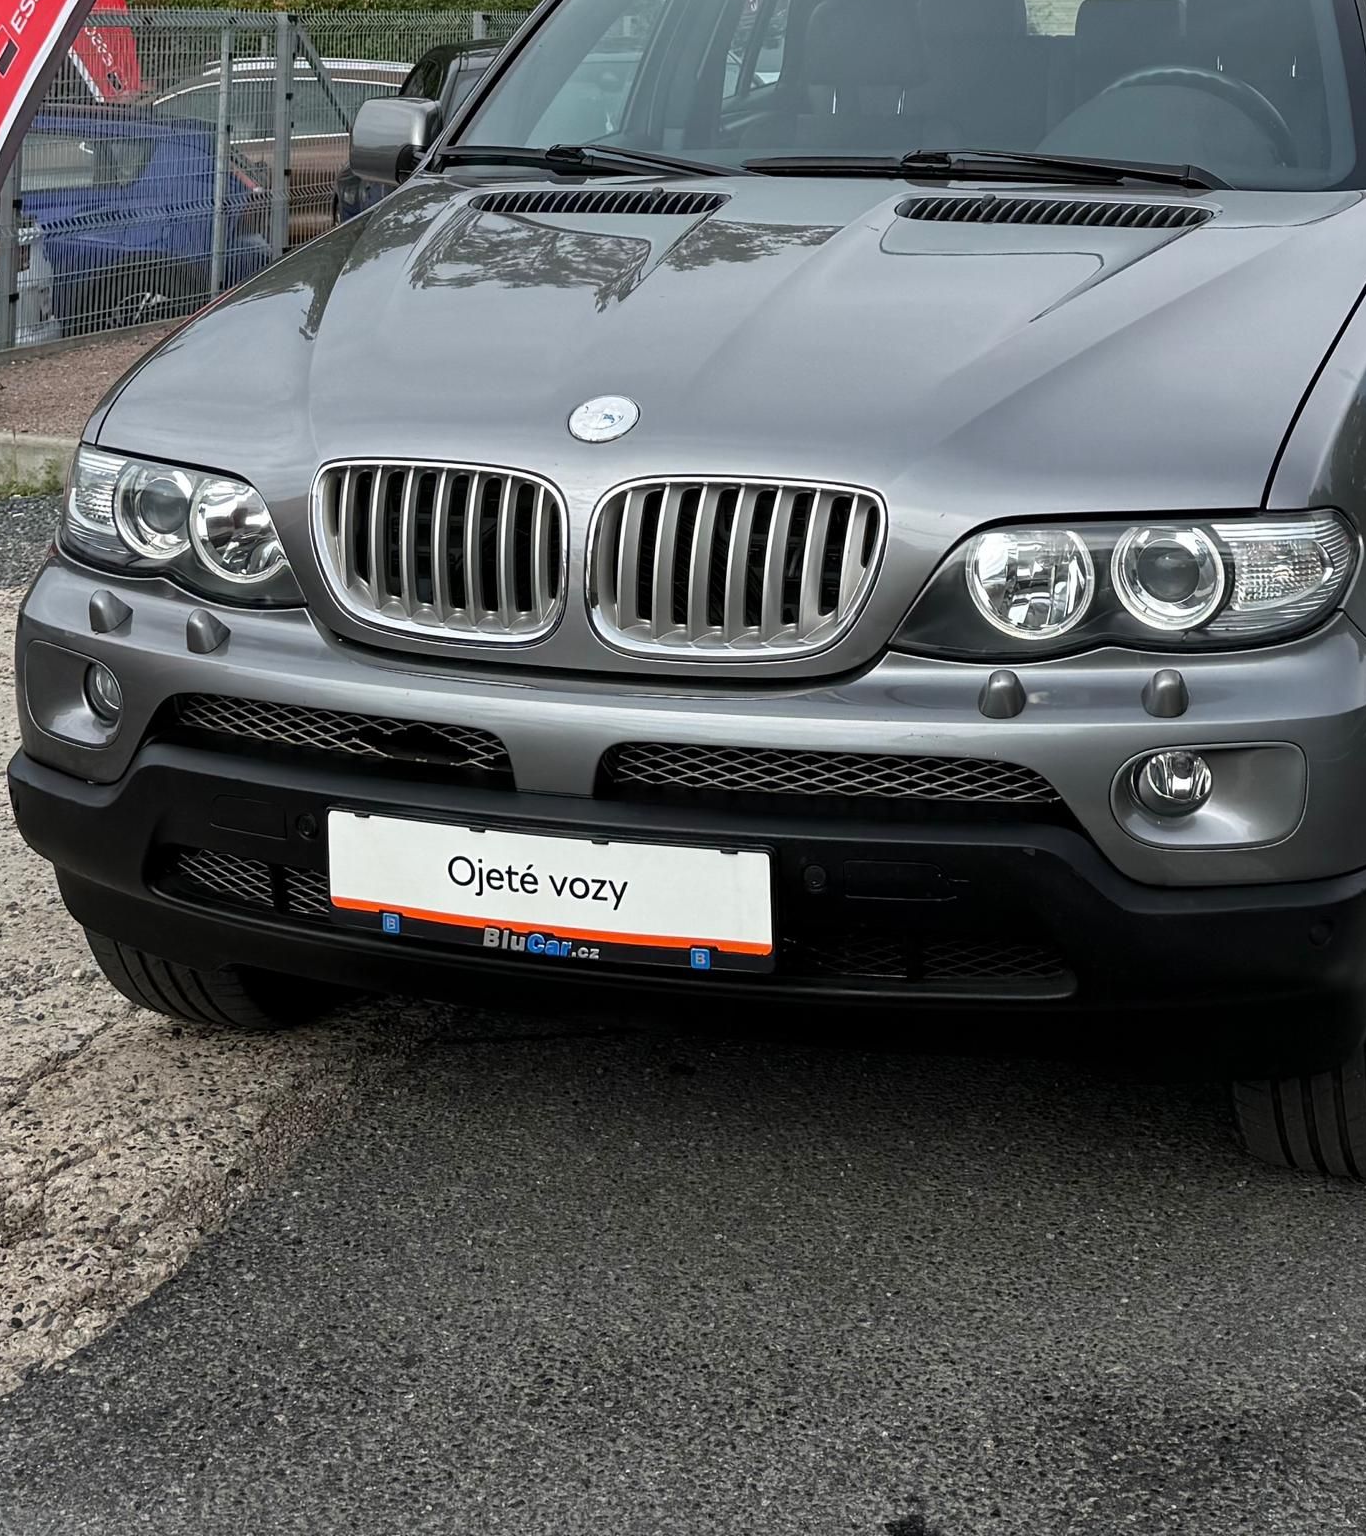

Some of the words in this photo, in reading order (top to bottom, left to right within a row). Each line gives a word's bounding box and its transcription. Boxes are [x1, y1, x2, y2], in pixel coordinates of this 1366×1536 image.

[447, 855, 539, 897] Ojeté
[548, 874, 629, 911] vozy
[482, 927, 600, 960] BluCar.cz
